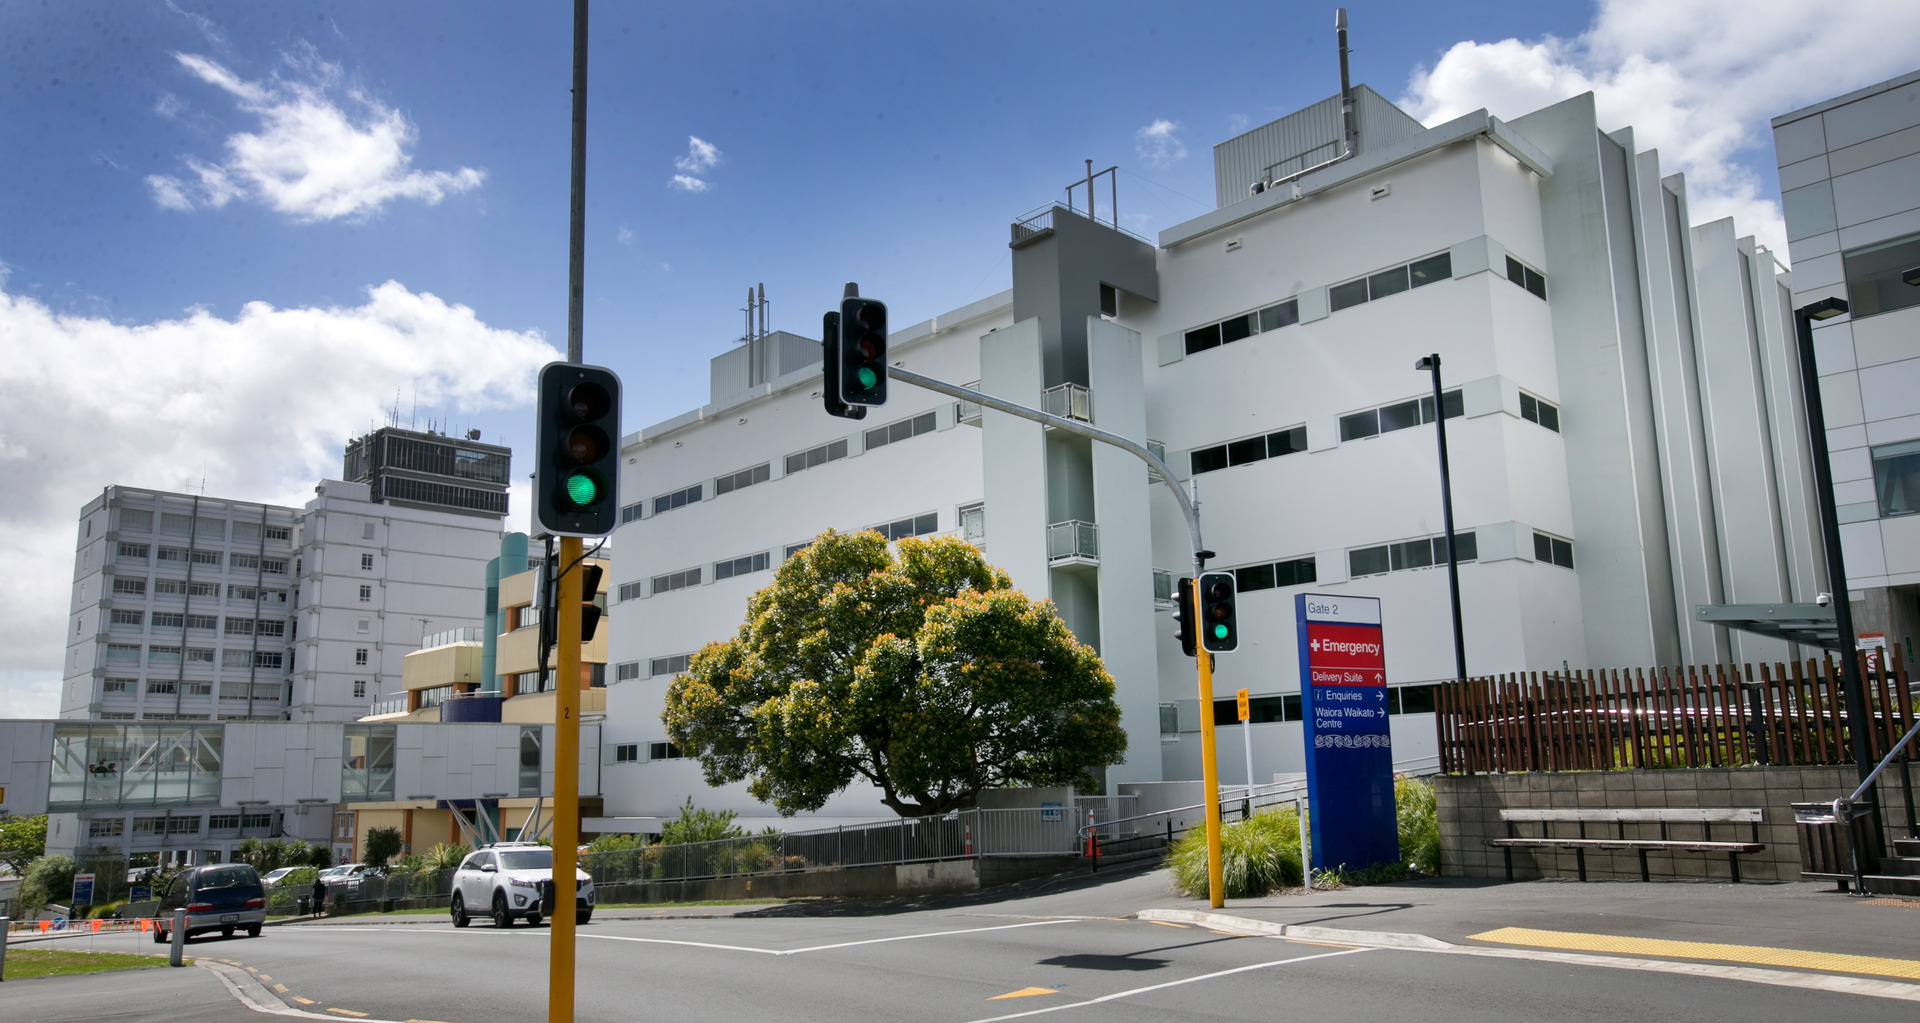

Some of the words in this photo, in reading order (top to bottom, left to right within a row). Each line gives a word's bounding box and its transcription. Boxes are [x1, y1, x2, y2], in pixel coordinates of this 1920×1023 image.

[1308, 602, 1330, 614] Gate
[1332, 604, 1338, 614] 2
[1322, 639, 1380, 656] Emergency
[1312, 671, 1342, 684] Delivery
[1343, 672, 1363, 683] Suite
[1326, 690, 1363, 702] Enquiries
[564, 707, 569, 719] 2
[1315, 707, 1342, 717] Waiora
[1343, 707, 1375, 718] Waikato
[1316, 718, 1342, 729] Centre
